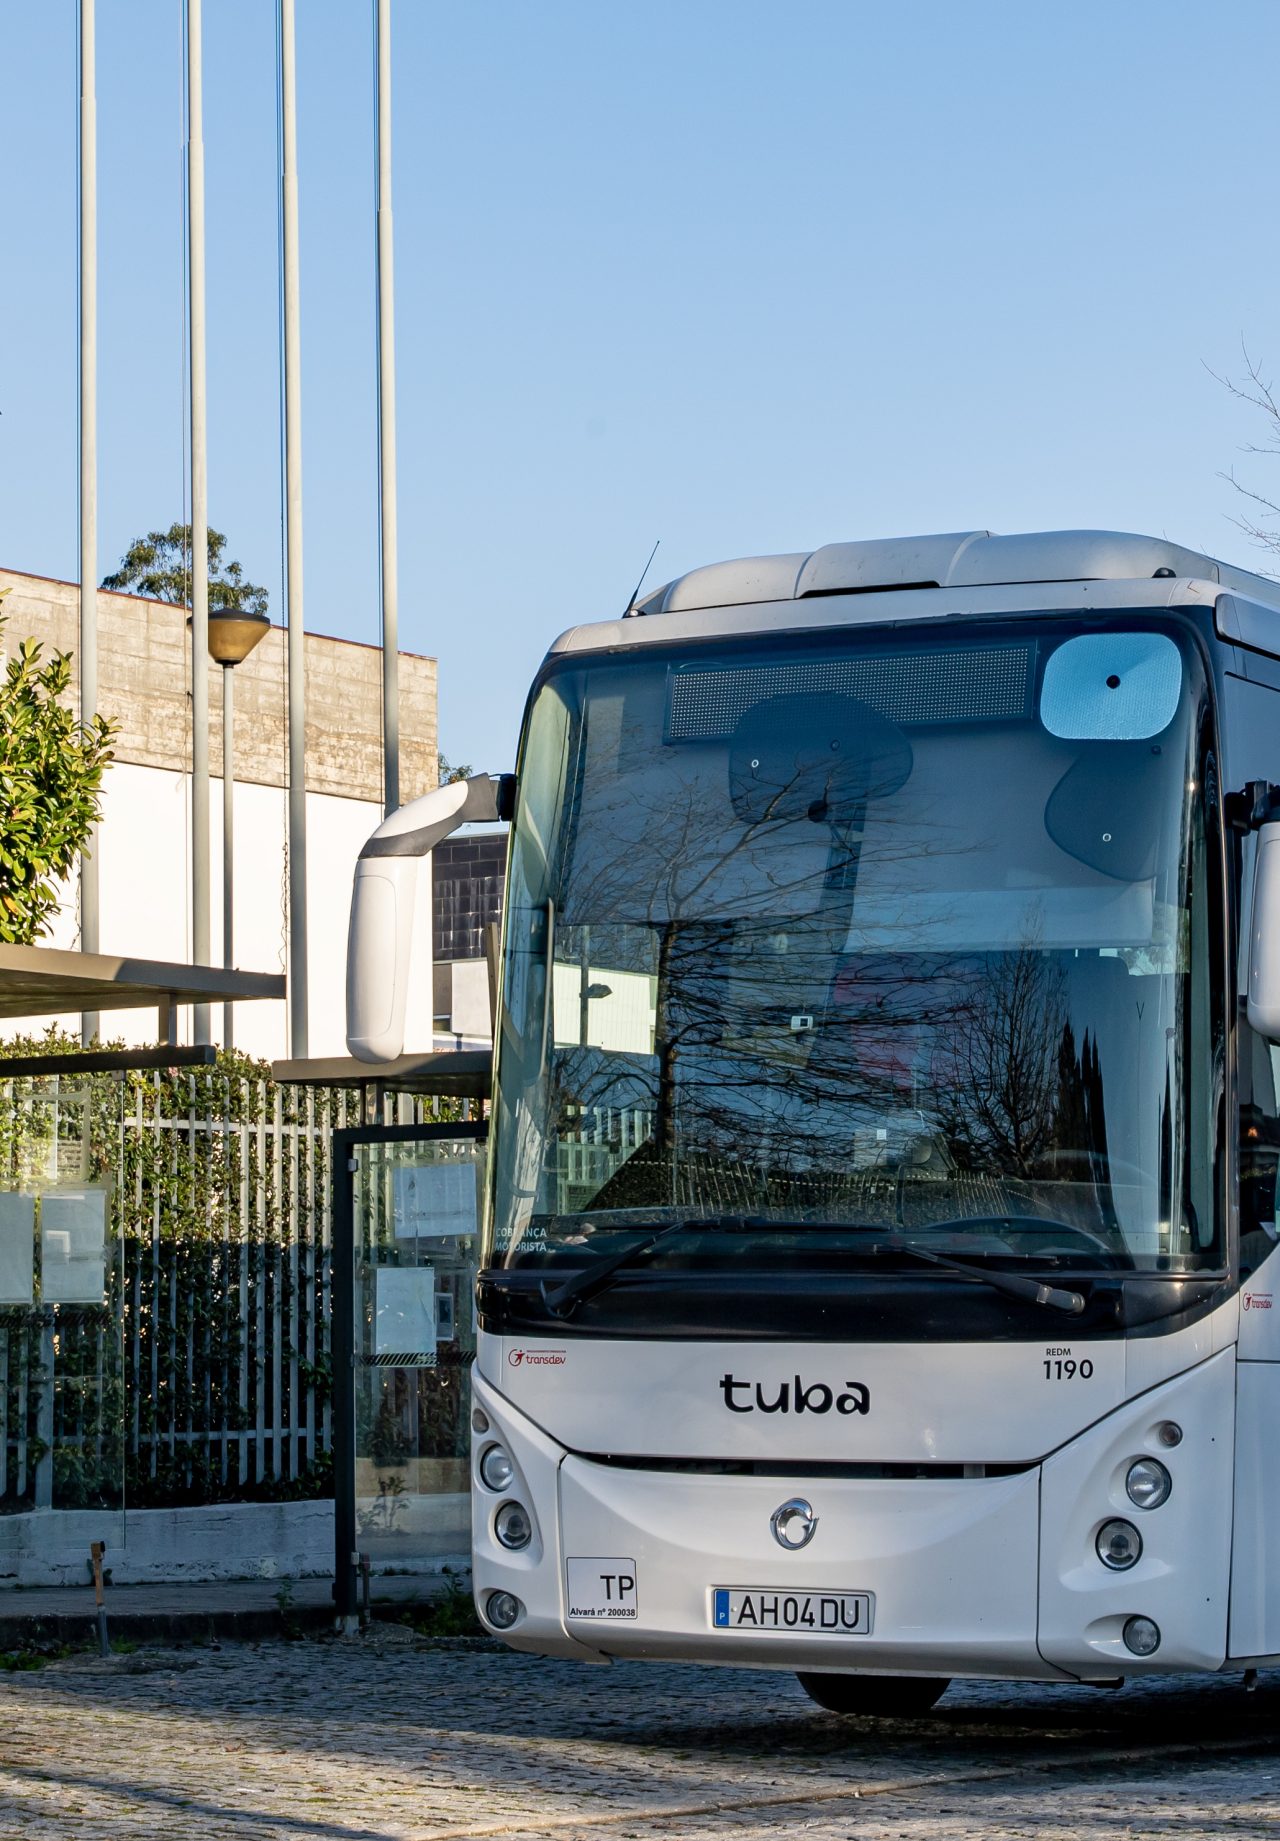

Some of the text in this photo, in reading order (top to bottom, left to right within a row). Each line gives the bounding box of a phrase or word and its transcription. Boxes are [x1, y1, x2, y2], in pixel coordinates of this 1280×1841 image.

[495, 1227, 547, 1239] COBANÇA
[495, 1241, 547, 1252] MOORISTA
[1046, 1348, 1072, 1356] REDM
[526, 1354, 566, 1365] transdev
[1043, 1359, 1093, 1380] 1190
[719, 1374, 870, 1415] tuba
[600, 1575, 634, 1600] TP
[569, 1608, 596, 1616] Alvará
[607, 1608, 636, 1616] 200038
[719, 1612, 726, 1620] P
